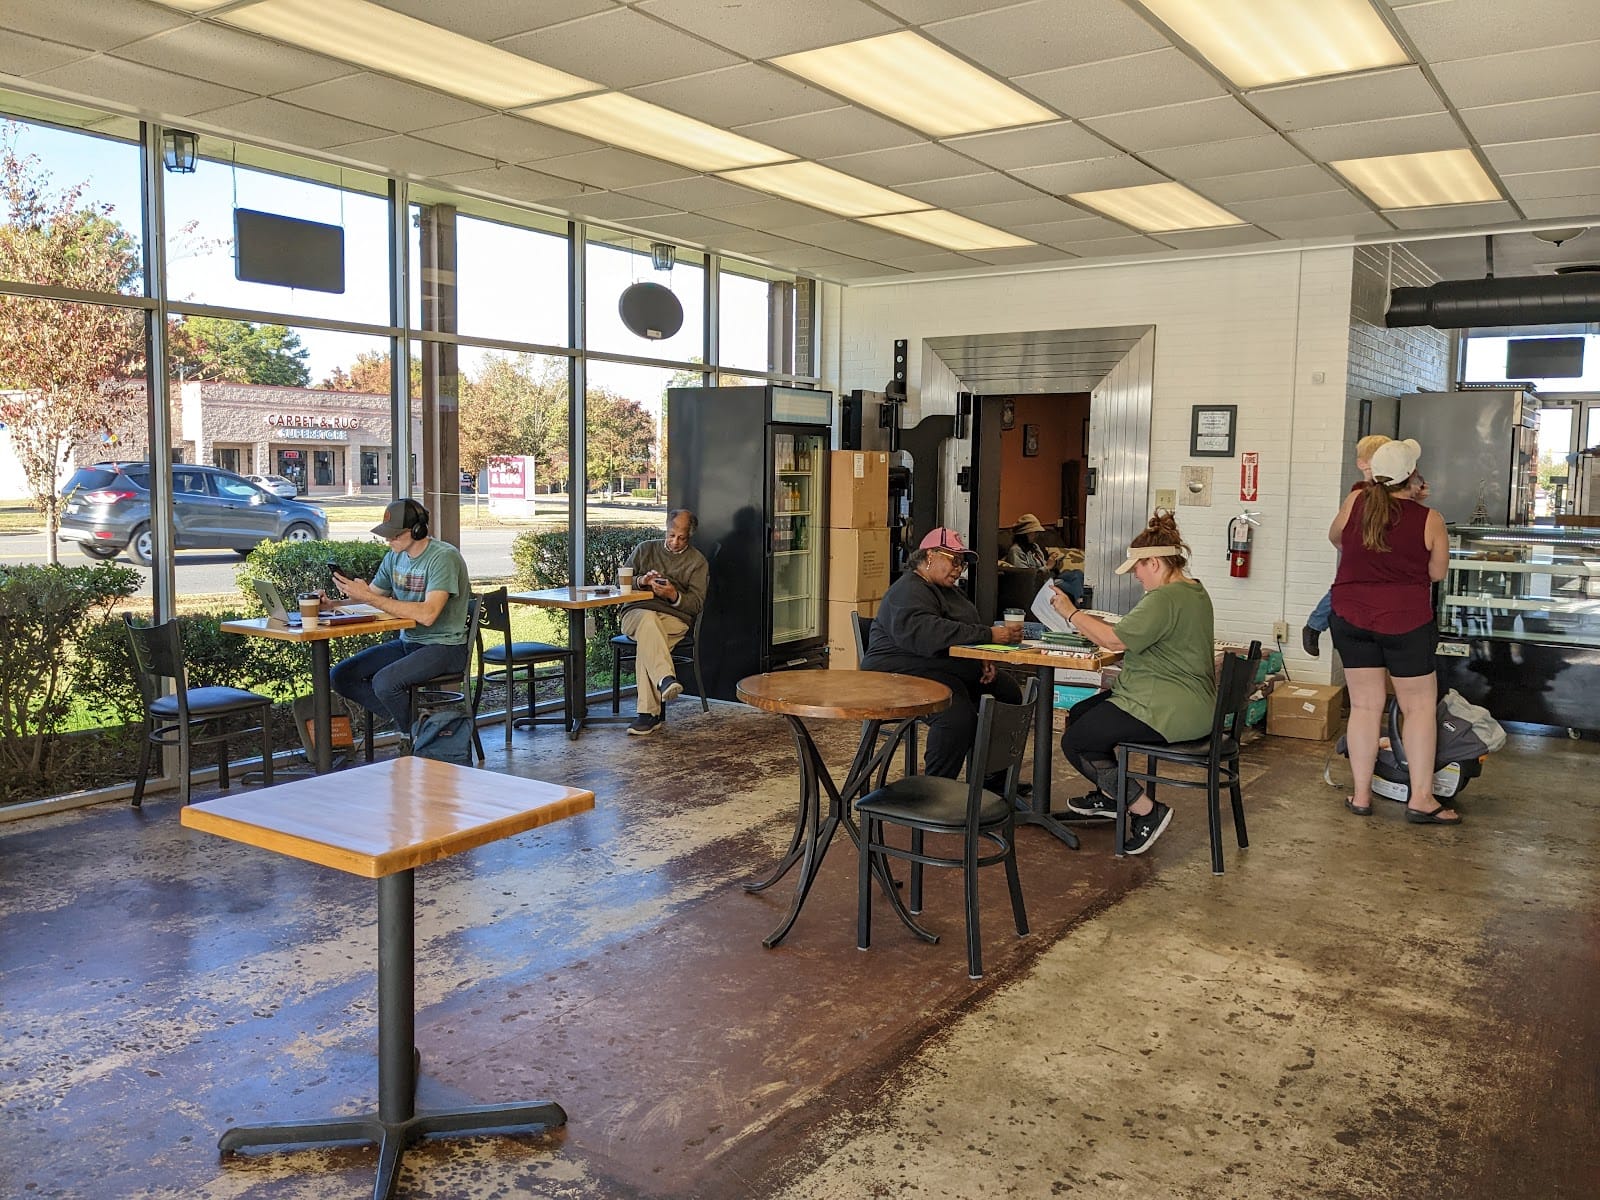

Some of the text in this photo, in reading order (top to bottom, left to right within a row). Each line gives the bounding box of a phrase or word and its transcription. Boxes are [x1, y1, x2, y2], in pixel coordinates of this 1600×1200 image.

[268, 414, 359, 429] CARPET & RUG
[280, 427, 348, 440] SUPERSTORE
[500, 472, 522, 485] RUG
